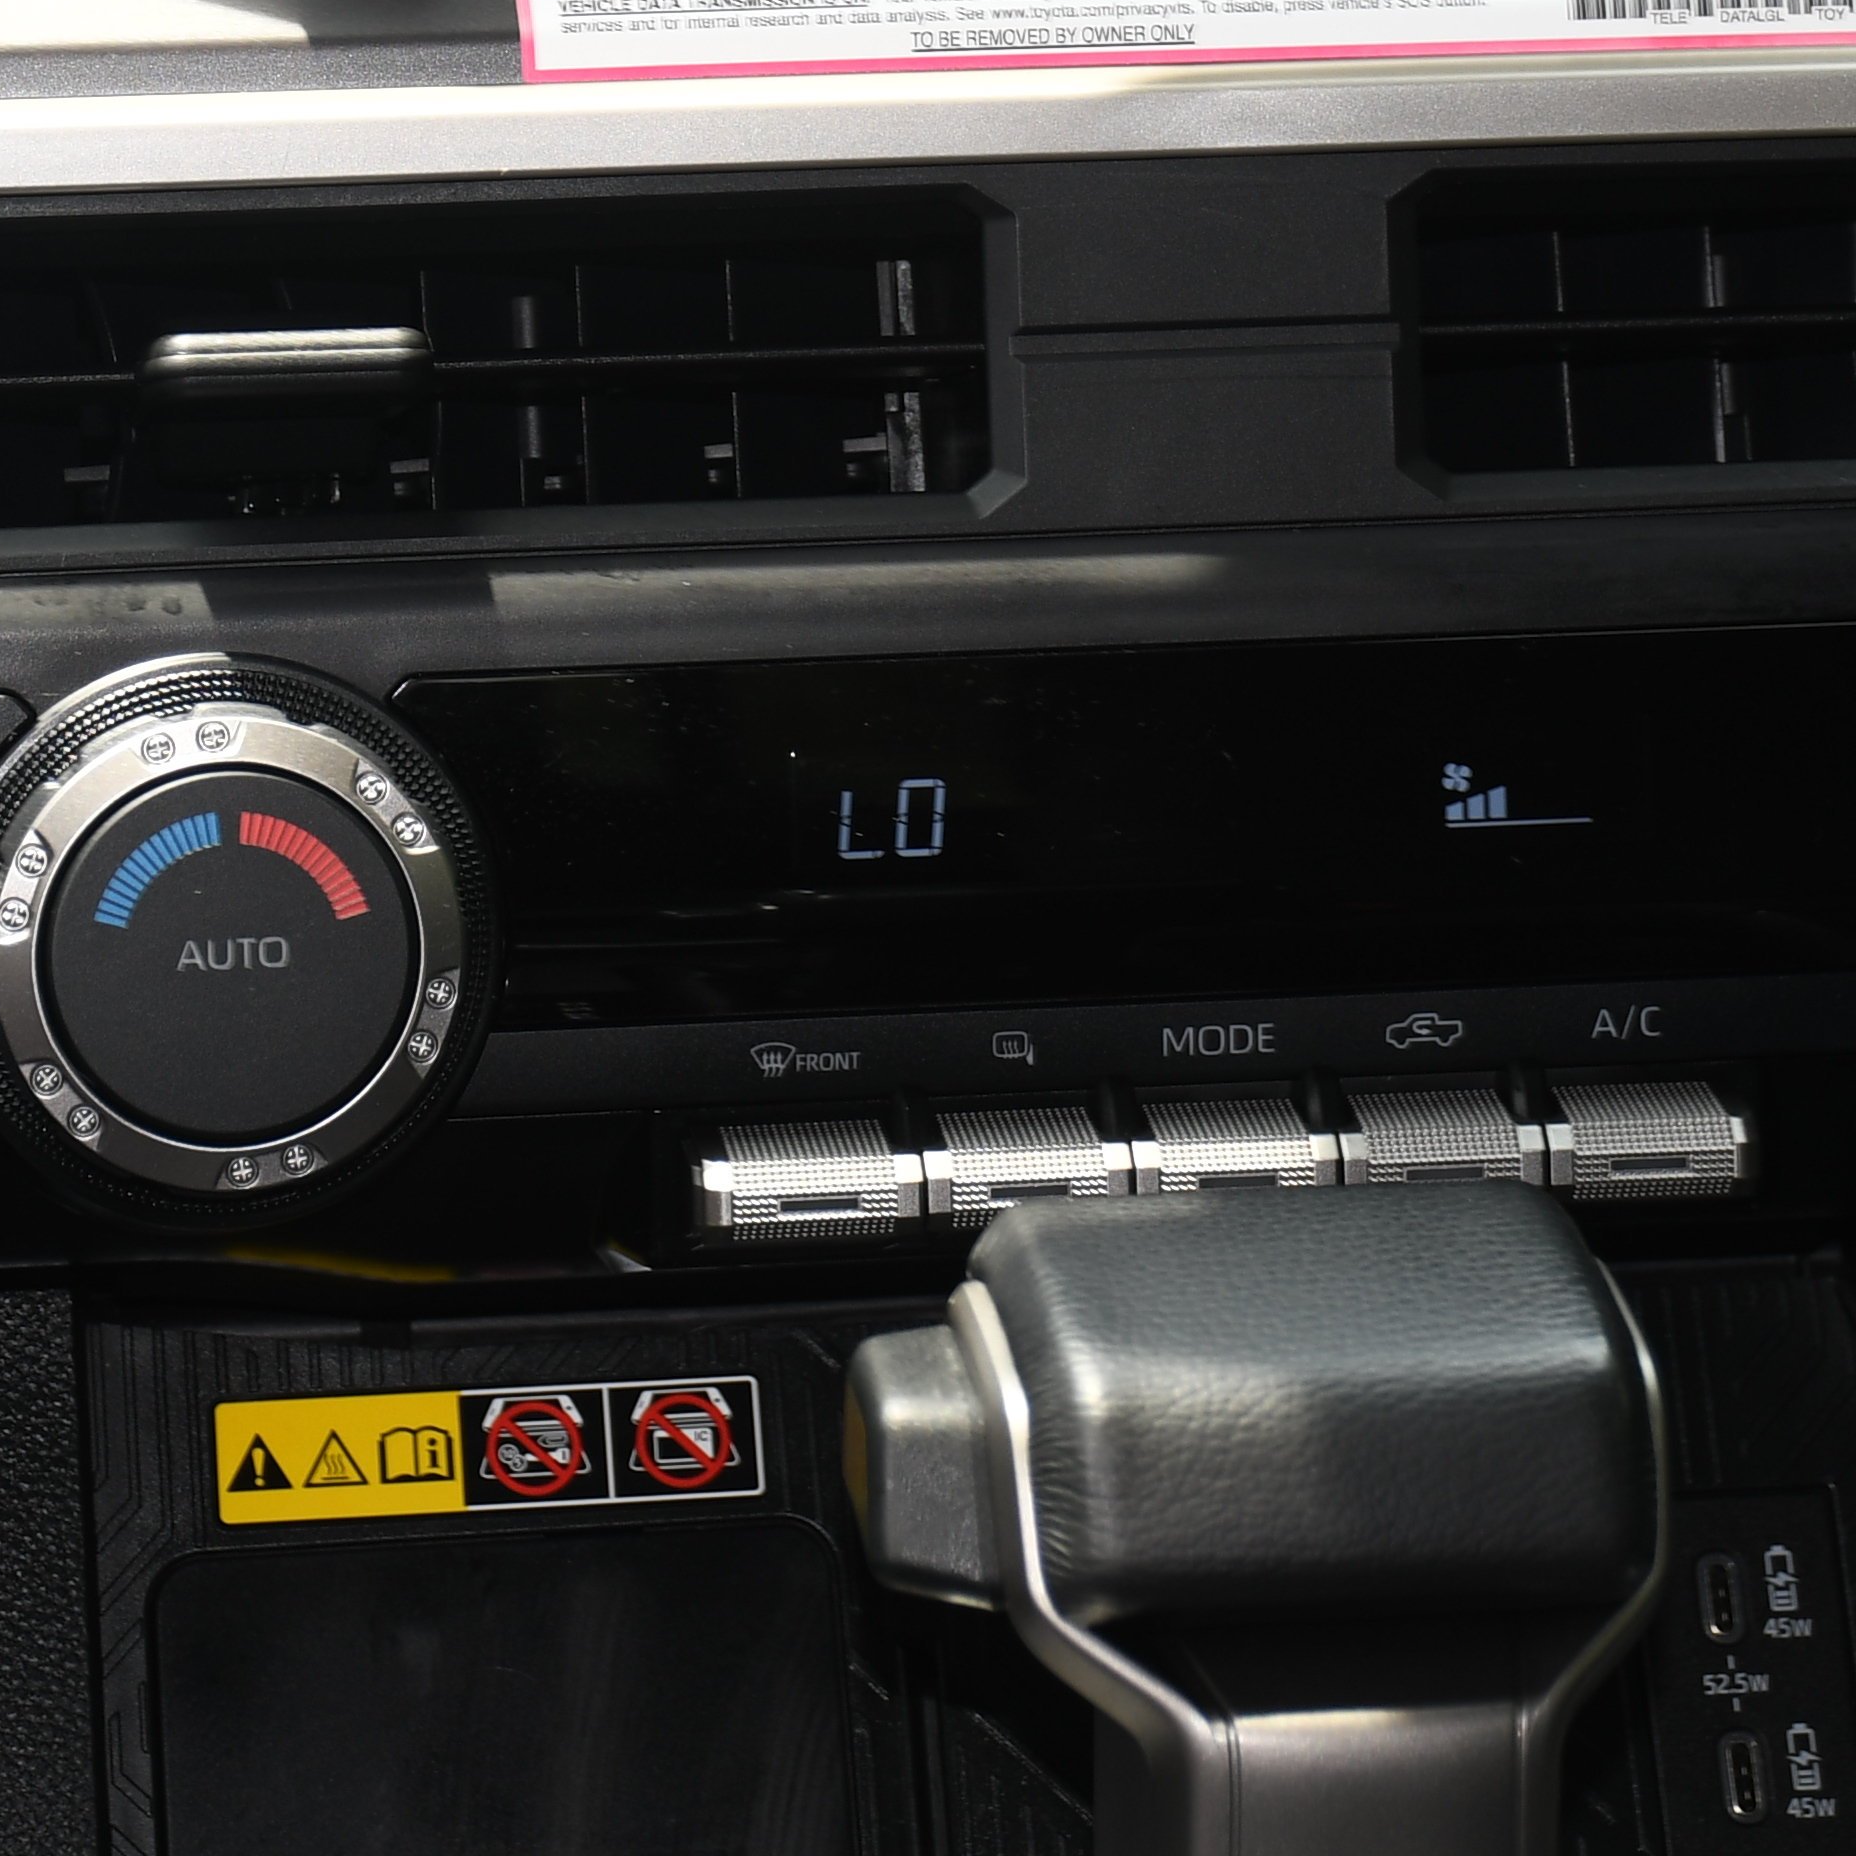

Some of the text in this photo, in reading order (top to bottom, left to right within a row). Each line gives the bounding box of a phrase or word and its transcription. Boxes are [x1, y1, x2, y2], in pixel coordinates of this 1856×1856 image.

[560, 19, 622, 33] services
[628, 18, 655, 31] and
[686, 15, 740, 29] internal
[745, 13, 808, 27] research
[815, 12, 842, 25] and
[847, 10, 881, 25] data
[956, 7, 984, 21] See
[1199, 0, 1216, 13] To
[1649, 7, 1846, 24] TELE DATALGL TOY
[910, 23, 1195, 49] TO BE REMOVED BY OWNER ONLY
[177, 936, 289, 971] AUTO
[1591, 1005, 1661, 1040] A/C
[1162, 1023, 1275, 1057] MODE
[792, 1045, 861, 1072] FRONT
[1764, 1617, 1811, 1638] 45W
[1703, 1672, 1768, 1695] 52.5W
[1787, 1797, 1835, 1818] 45W
